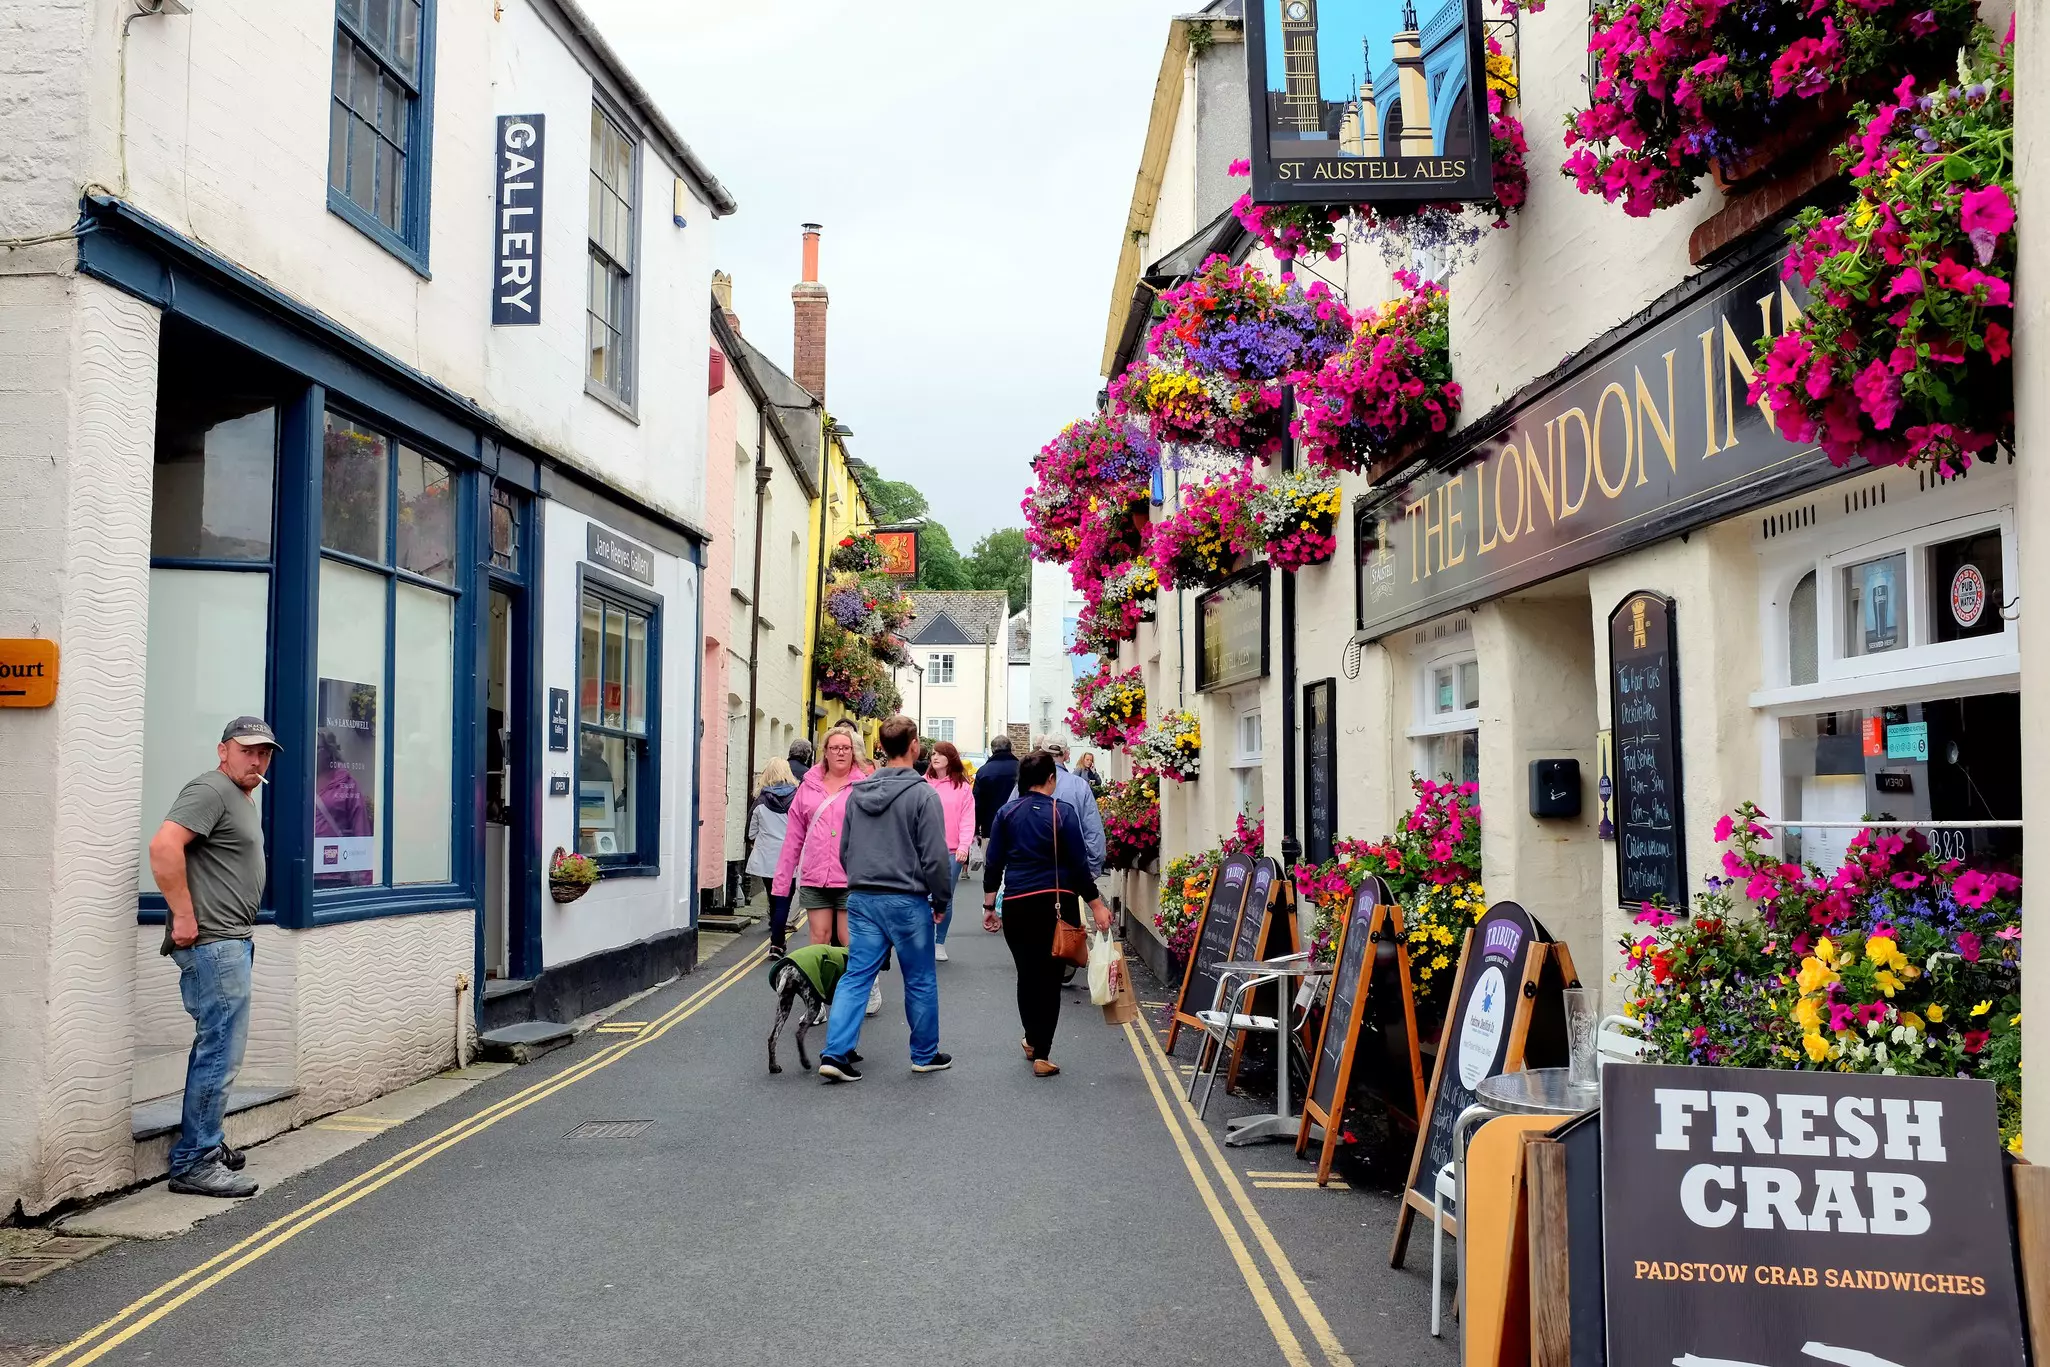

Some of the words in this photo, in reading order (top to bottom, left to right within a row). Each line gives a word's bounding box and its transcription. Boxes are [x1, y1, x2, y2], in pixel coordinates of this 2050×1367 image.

[1278, 162, 1305, 180] ST
[1312, 161, 1407, 179] AUSTELL
[1413, 160, 1466, 178] ALES
[501, 122, 537, 313] GALLERY
[1405, 472, 1466, 584] THE
[1476, 348, 1678, 556] LONDON
[1698, 280, 1803, 461] IN
[1961, 581, 1973, 592] PUB
[0, 661, 44, 678] ourt
[555, 781, 565, 790] OPEN
[1928, 829, 1965, 861] B&B
[1225, 866, 1245, 881] TRIBUTE
[1486, 925, 1520, 954] TRIBUTE
[1654, 1088, 1947, 1162] FRESH
[1680, 1163, 1931, 1235] CRAB
[1634, 1260, 1748, 1283] PADSTOW
[1754, 1266, 1818, 1287] CRAB
[1825, 1269, 1986, 1296] SANDWICHES
